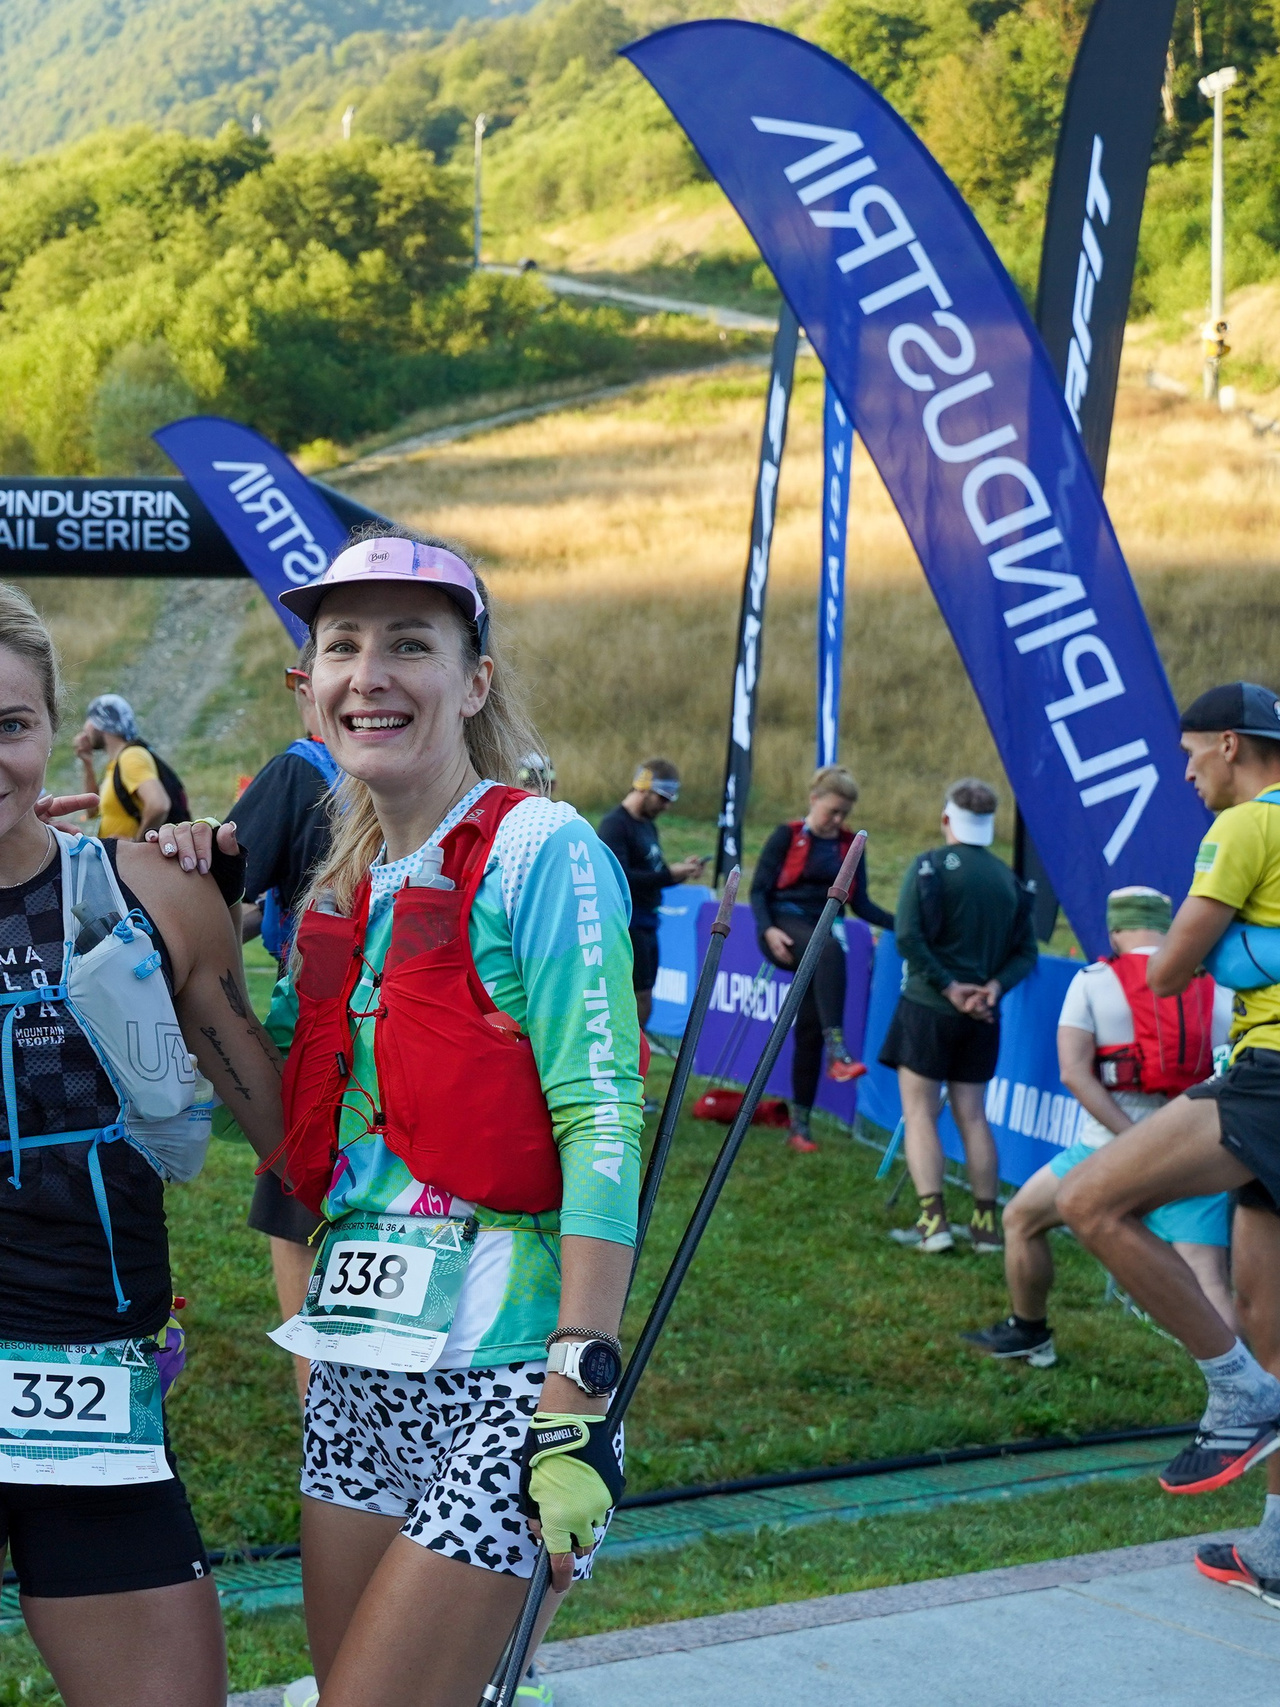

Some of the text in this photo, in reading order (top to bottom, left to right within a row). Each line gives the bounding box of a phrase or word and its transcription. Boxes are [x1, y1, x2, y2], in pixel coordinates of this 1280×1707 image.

[57, 519, 191, 552] SERIES
[568, 840, 603, 967] SERIES
[15, 1026, 65, 1039] MOUNTAIN
[17, 1034, 66, 1048] PEOPLE
[365, 1221, 385, 1231] TRAIL
[386, 1223, 397, 1232] 36
[329, 1252, 409, 1300] 338
[47, 1343, 74, 1353] TRAIL
[75, 1345, 87, 1354] 36
[10, 1372, 107, 1421] 332
[536, 1426, 573, 1444] TEMPESTA
